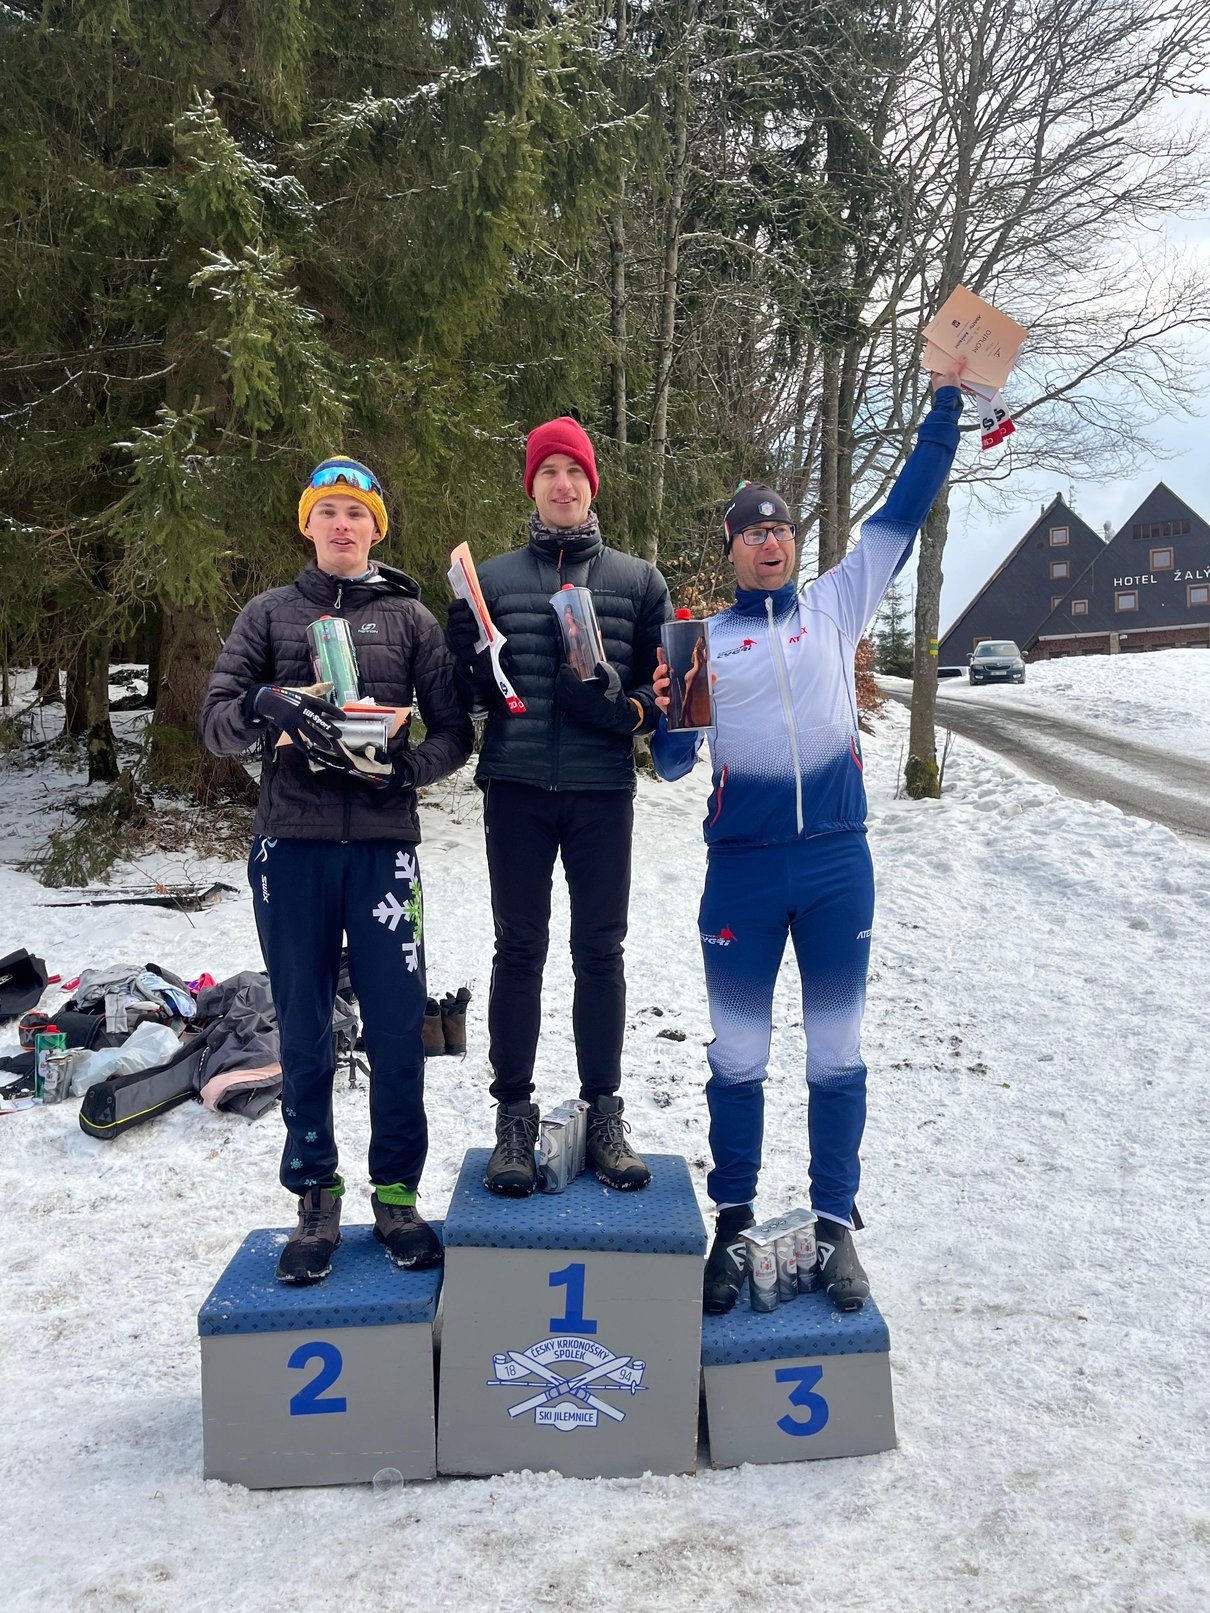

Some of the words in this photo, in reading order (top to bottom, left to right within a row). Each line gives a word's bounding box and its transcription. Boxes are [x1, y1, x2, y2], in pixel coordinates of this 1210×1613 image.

[972, 329, 992, 354] DIPLOM
[1113, 575, 1158, 587] HOTEL
[548, 1263, 597, 1335] 1
[530, 1340, 556, 1358] ČESKÝ
[557, 1339, 610, 1361] KRKONOŠSKÝ
[554, 1349, 586, 1361] SPOLEK
[287, 1341, 347, 1416] 2
[504, 1364, 517, 1377] 18
[618, 1369, 632, 1383] 94
[774, 1364, 830, 1437] 3
[539, 1411, 552, 1421] SKI
[553, 1411, 594, 1423] JILEMNICE
